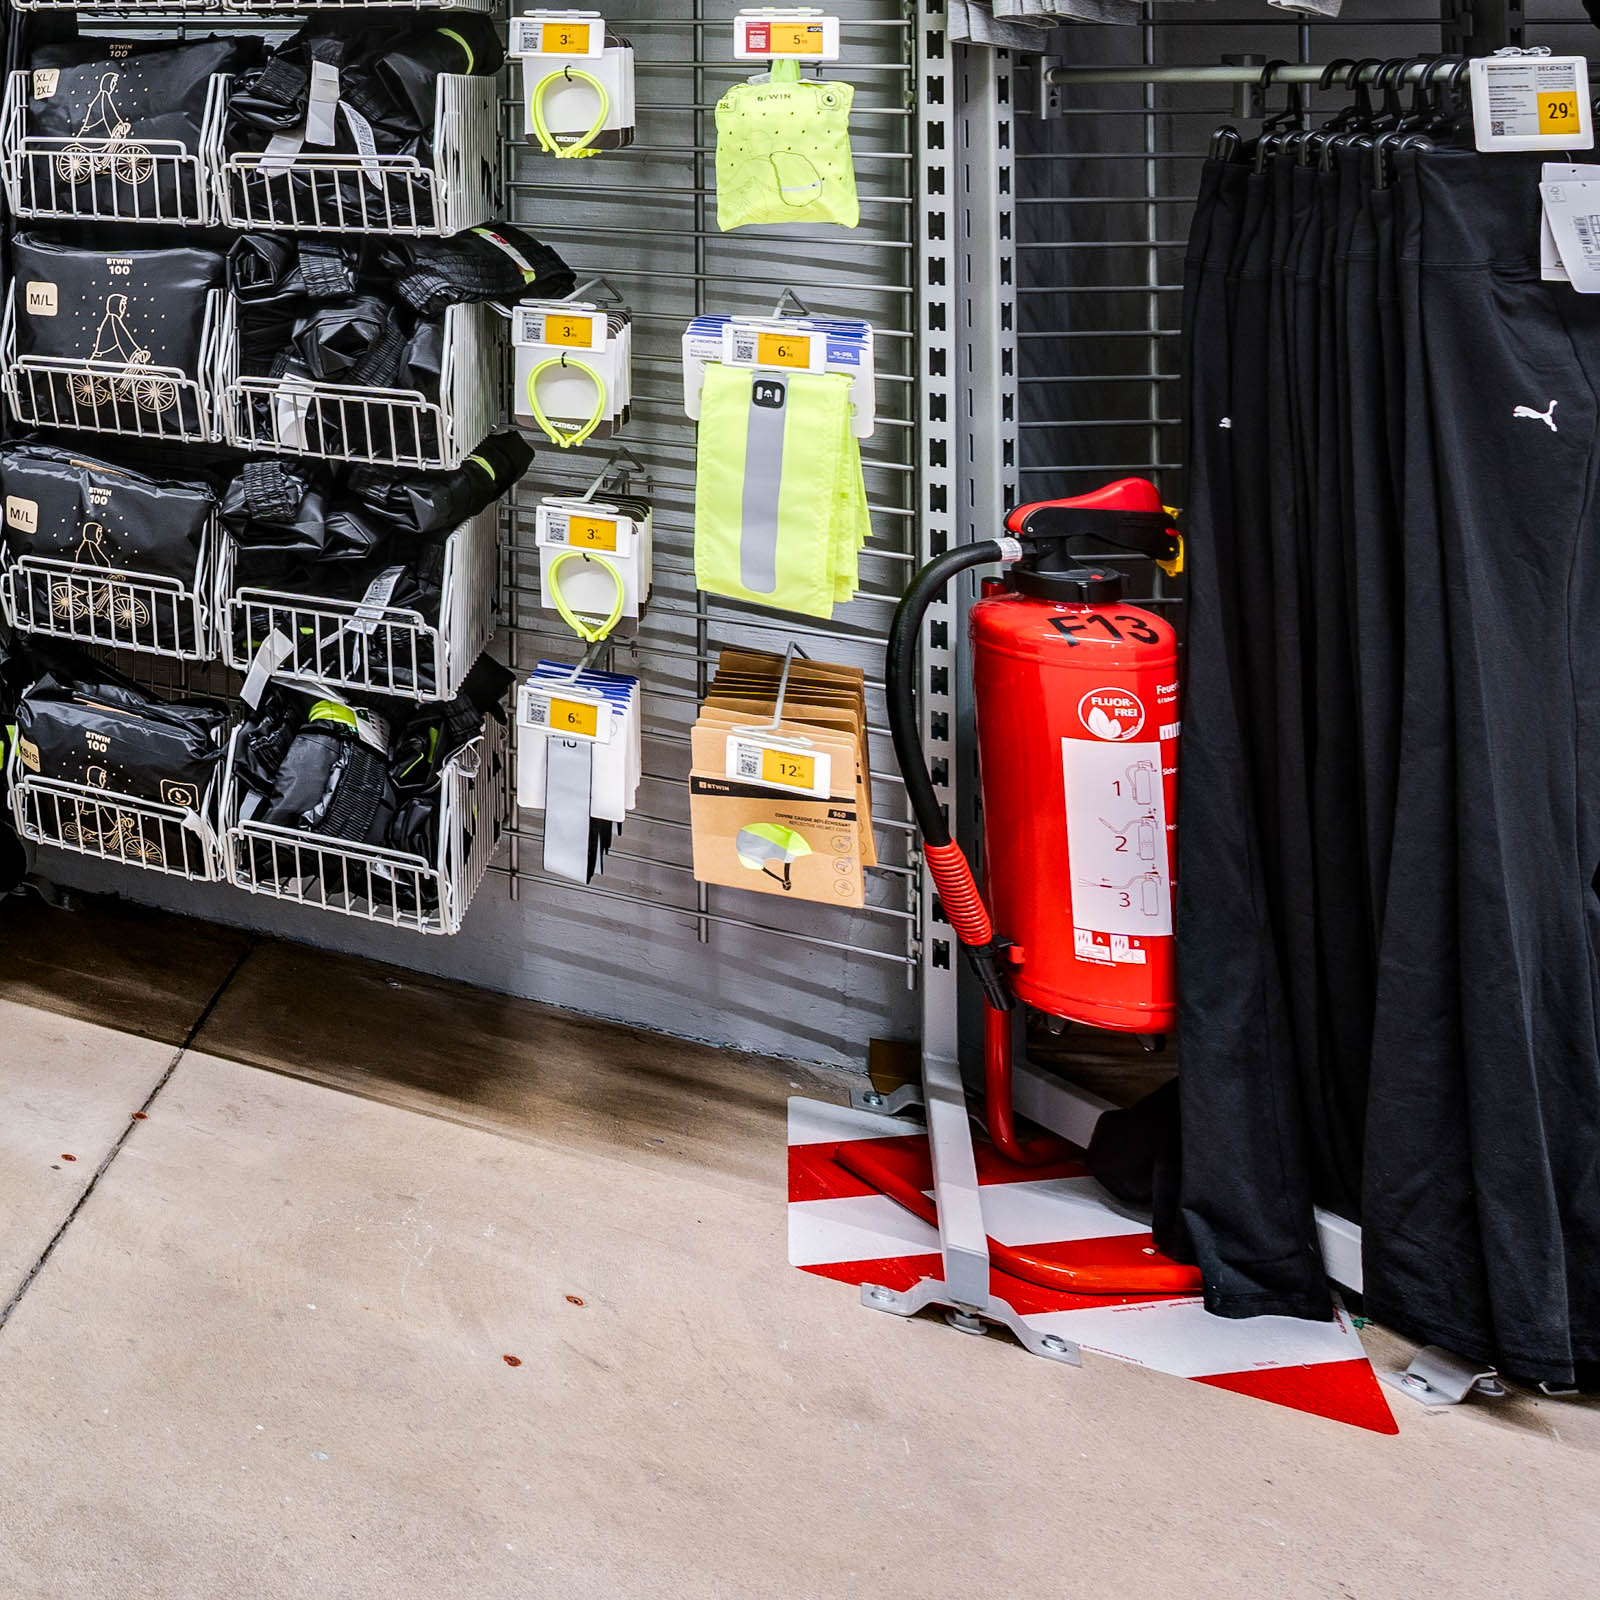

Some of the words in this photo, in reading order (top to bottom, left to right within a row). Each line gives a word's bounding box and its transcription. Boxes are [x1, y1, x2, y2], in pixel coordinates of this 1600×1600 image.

[559, 34, 568, 45] 3
[793, 34, 801, 45] 5
[110, 50, 129, 58] 100
[35, 72, 54, 83] XL/
[36, 85, 52, 96] 2XL
[1547, 102, 1568, 119] 29
[106, 258, 133, 266] BTWIN
[108, 265, 130, 275] 100
[30, 293, 54, 307] M/L
[563, 326, 570, 338] 3
[778, 346, 786, 358] 6
[88, 486, 112, 496] BTWIN
[90, 495, 108, 506] 100
[9, 507, 34, 524] M/L
[586, 528, 595, 540] 3
[1047, 614, 1159, 647] F13
[1091, 696, 1134, 706] FLUOR-
[568, 712, 576, 724] 6
[1114, 708, 1138, 717] FREI
[85, 731, 111, 744] BTWIN
[87, 740, 108, 753] 100
[779, 763, 798, 777] 12
[1112, 780, 1120, 797] 1
[1114, 835, 1128, 852] 2
[1119, 892, 1131, 908] 3
[1096, 936, 1104, 944] A
